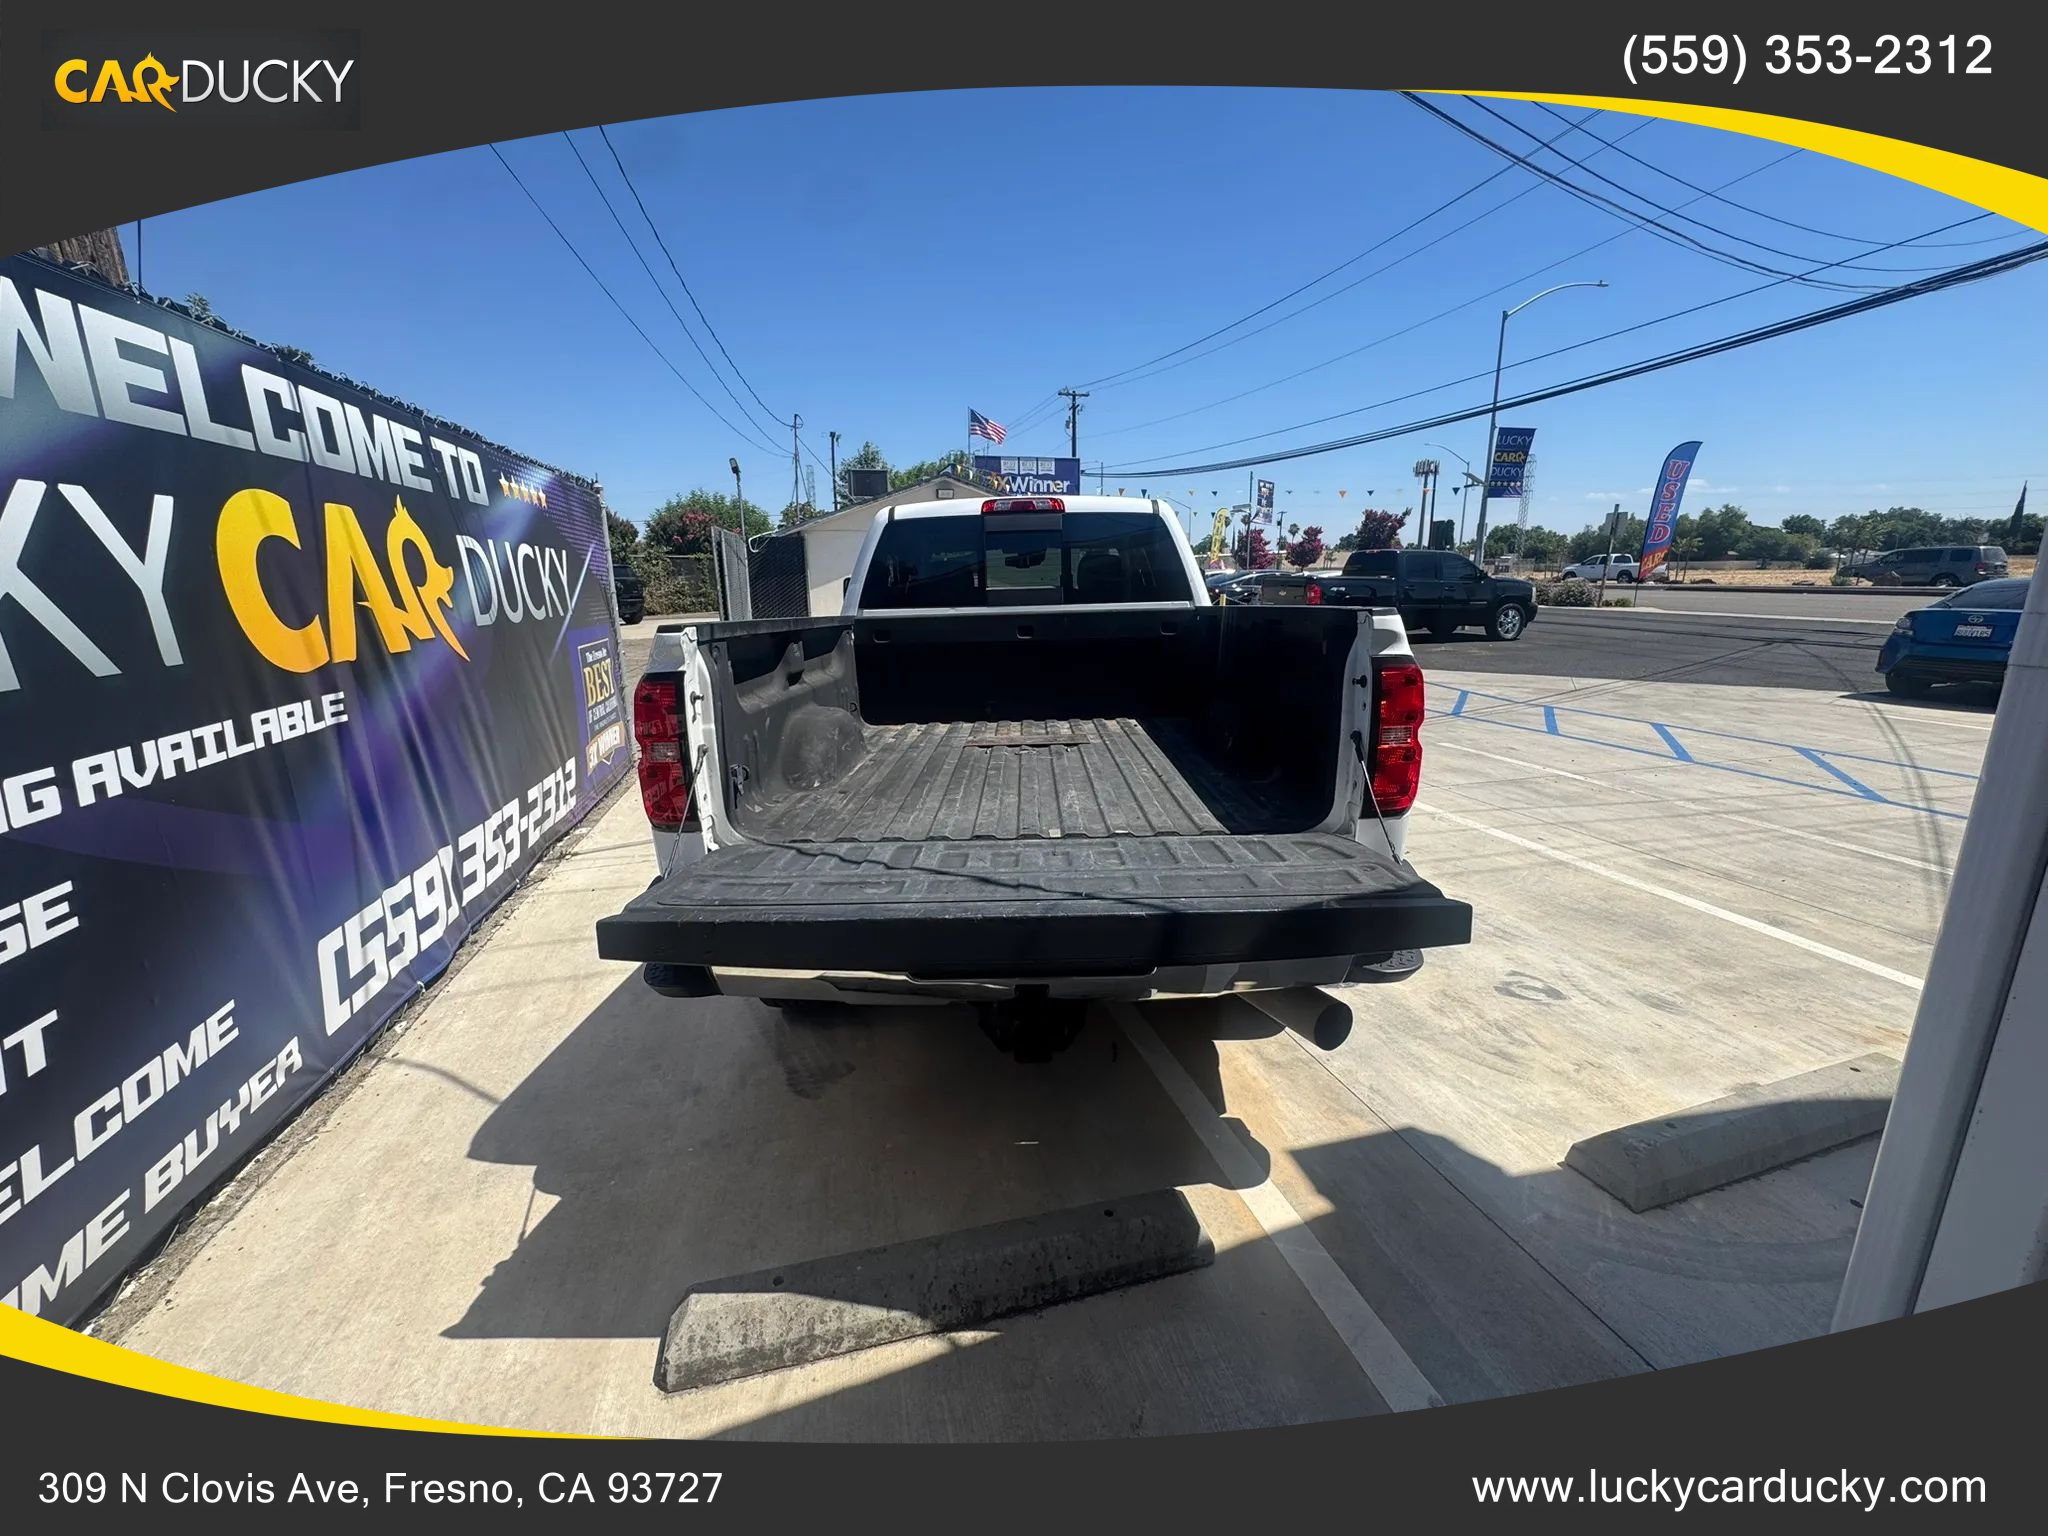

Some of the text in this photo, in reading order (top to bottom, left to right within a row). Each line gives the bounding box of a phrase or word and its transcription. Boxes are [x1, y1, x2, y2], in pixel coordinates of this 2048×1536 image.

[429, 436, 489, 506] TO
[1491, 466, 1524, 477] DUCKY
[1497, 435, 1533, 446] LUCKY
[1648, 459, 1690, 544] USED
[216, 488, 470, 673] CAR
[455, 534, 573, 626] DUCKY
[583, 657, 615, 707] BEST
[72, 691, 349, 807] AVAILABLE
[317, 756, 577, 1037] (559) 353-2312
[144, 1036, 303, 1214] BUYER
